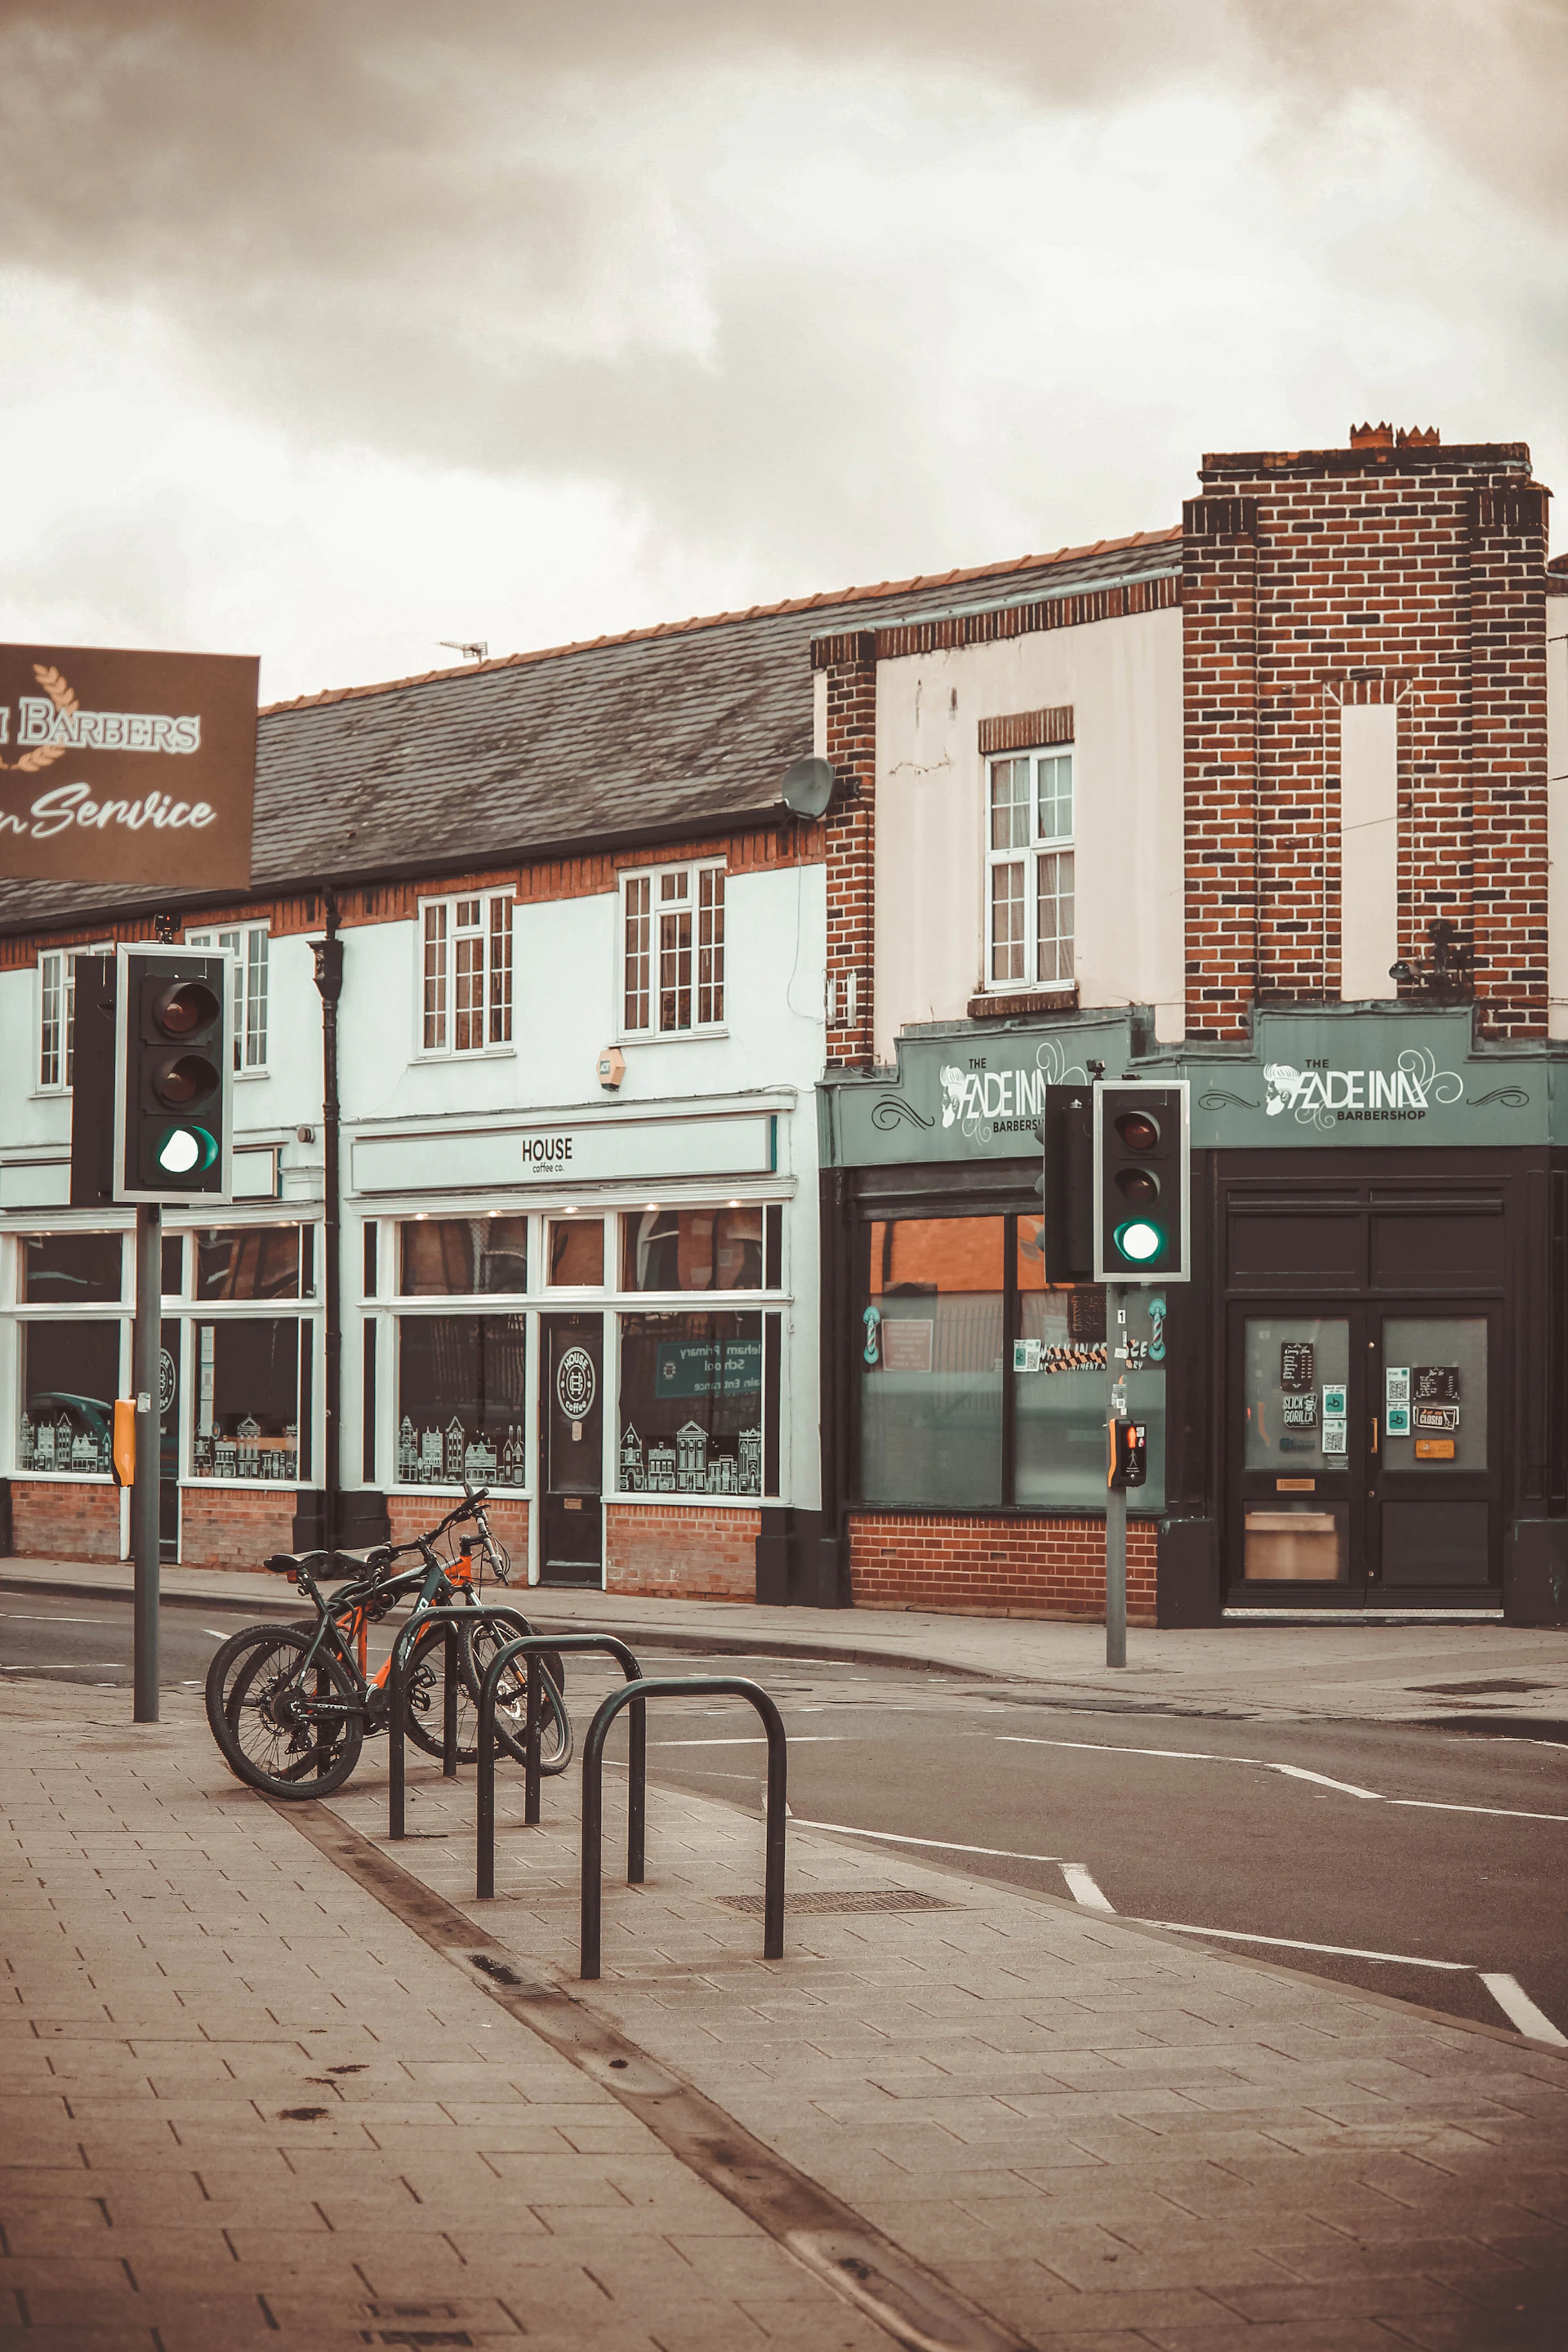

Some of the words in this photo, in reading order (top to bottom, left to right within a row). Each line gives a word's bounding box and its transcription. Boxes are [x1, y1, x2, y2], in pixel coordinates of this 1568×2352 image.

[17, 697, 201, 755] BARBERS
[31, 782, 216, 838] Service
[969, 1058, 987, 1069] THE
[1306, 1059, 1330, 1068] THE
[1337, 1111, 1426, 1120] BARBERSHOP
[993, 1120, 1044, 1133] BARBERS
[523, 1138, 572, 1161] HOUSE
[532, 1162, 553, 1173] coffee
[564, 1352, 589, 1371] HOUSE
[565, 1400, 586, 1414] coffee
[1284, 1396, 1304, 1409] SLICK
[1285, 1410, 1313, 1423] GORILLA
[1420, 1414, 1443, 1426] CLOSED
